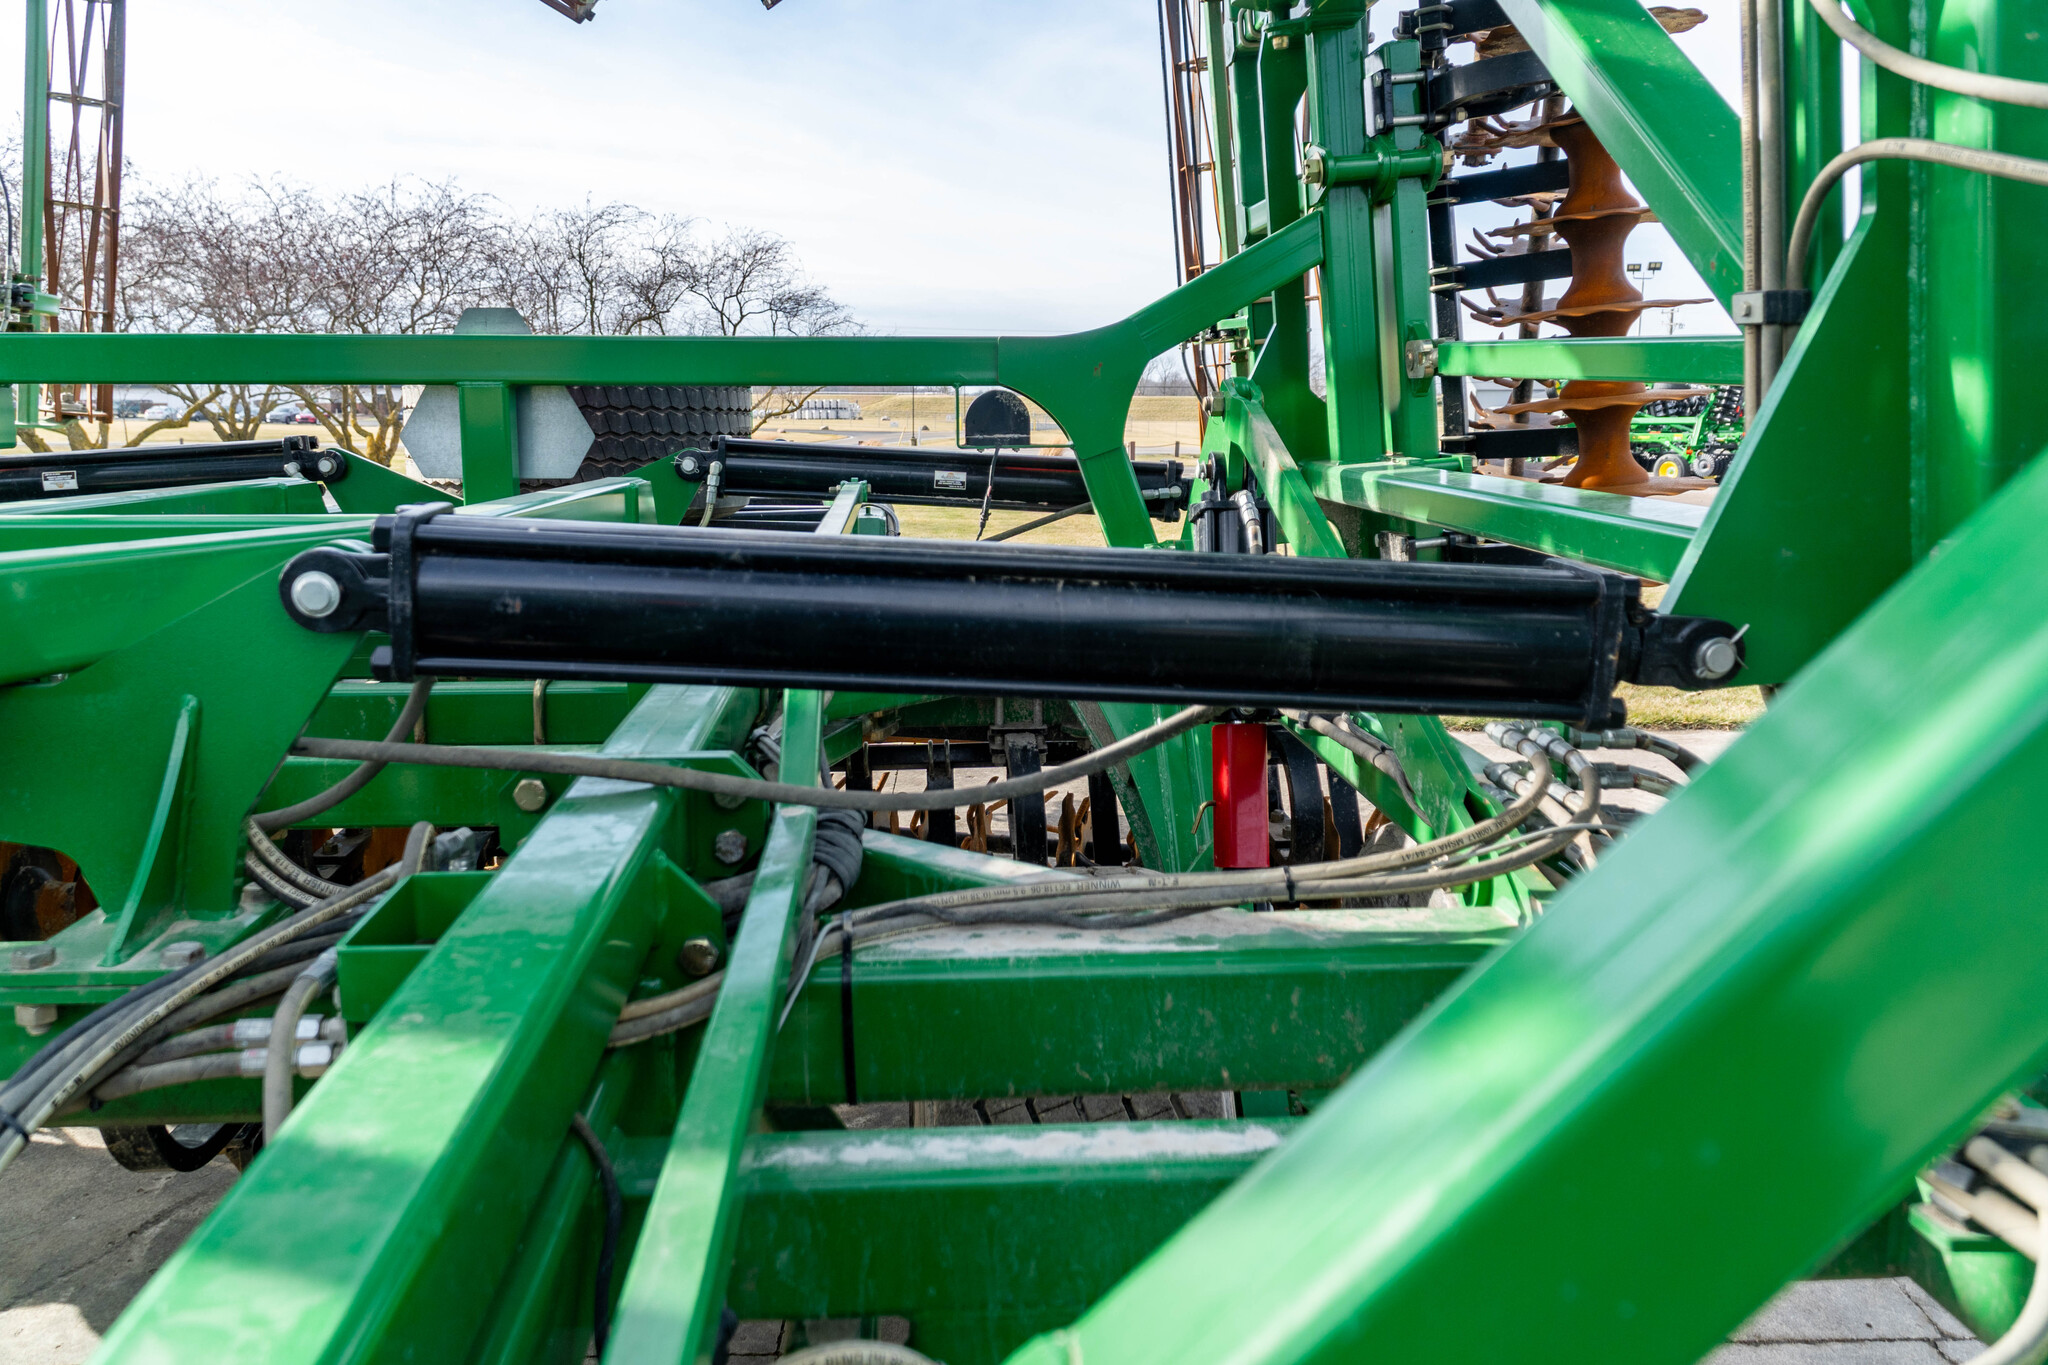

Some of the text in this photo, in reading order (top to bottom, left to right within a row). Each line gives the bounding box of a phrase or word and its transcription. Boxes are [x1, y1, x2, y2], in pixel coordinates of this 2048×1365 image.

[1468, 827, 1493, 841] 100R17
[1439, 838, 1465, 851] MSHA
[1402, 848, 1437, 862] IC-84/41
[1031, 884, 1071, 895] EC118-06
[1077, 879, 1121, 894] WINNER
